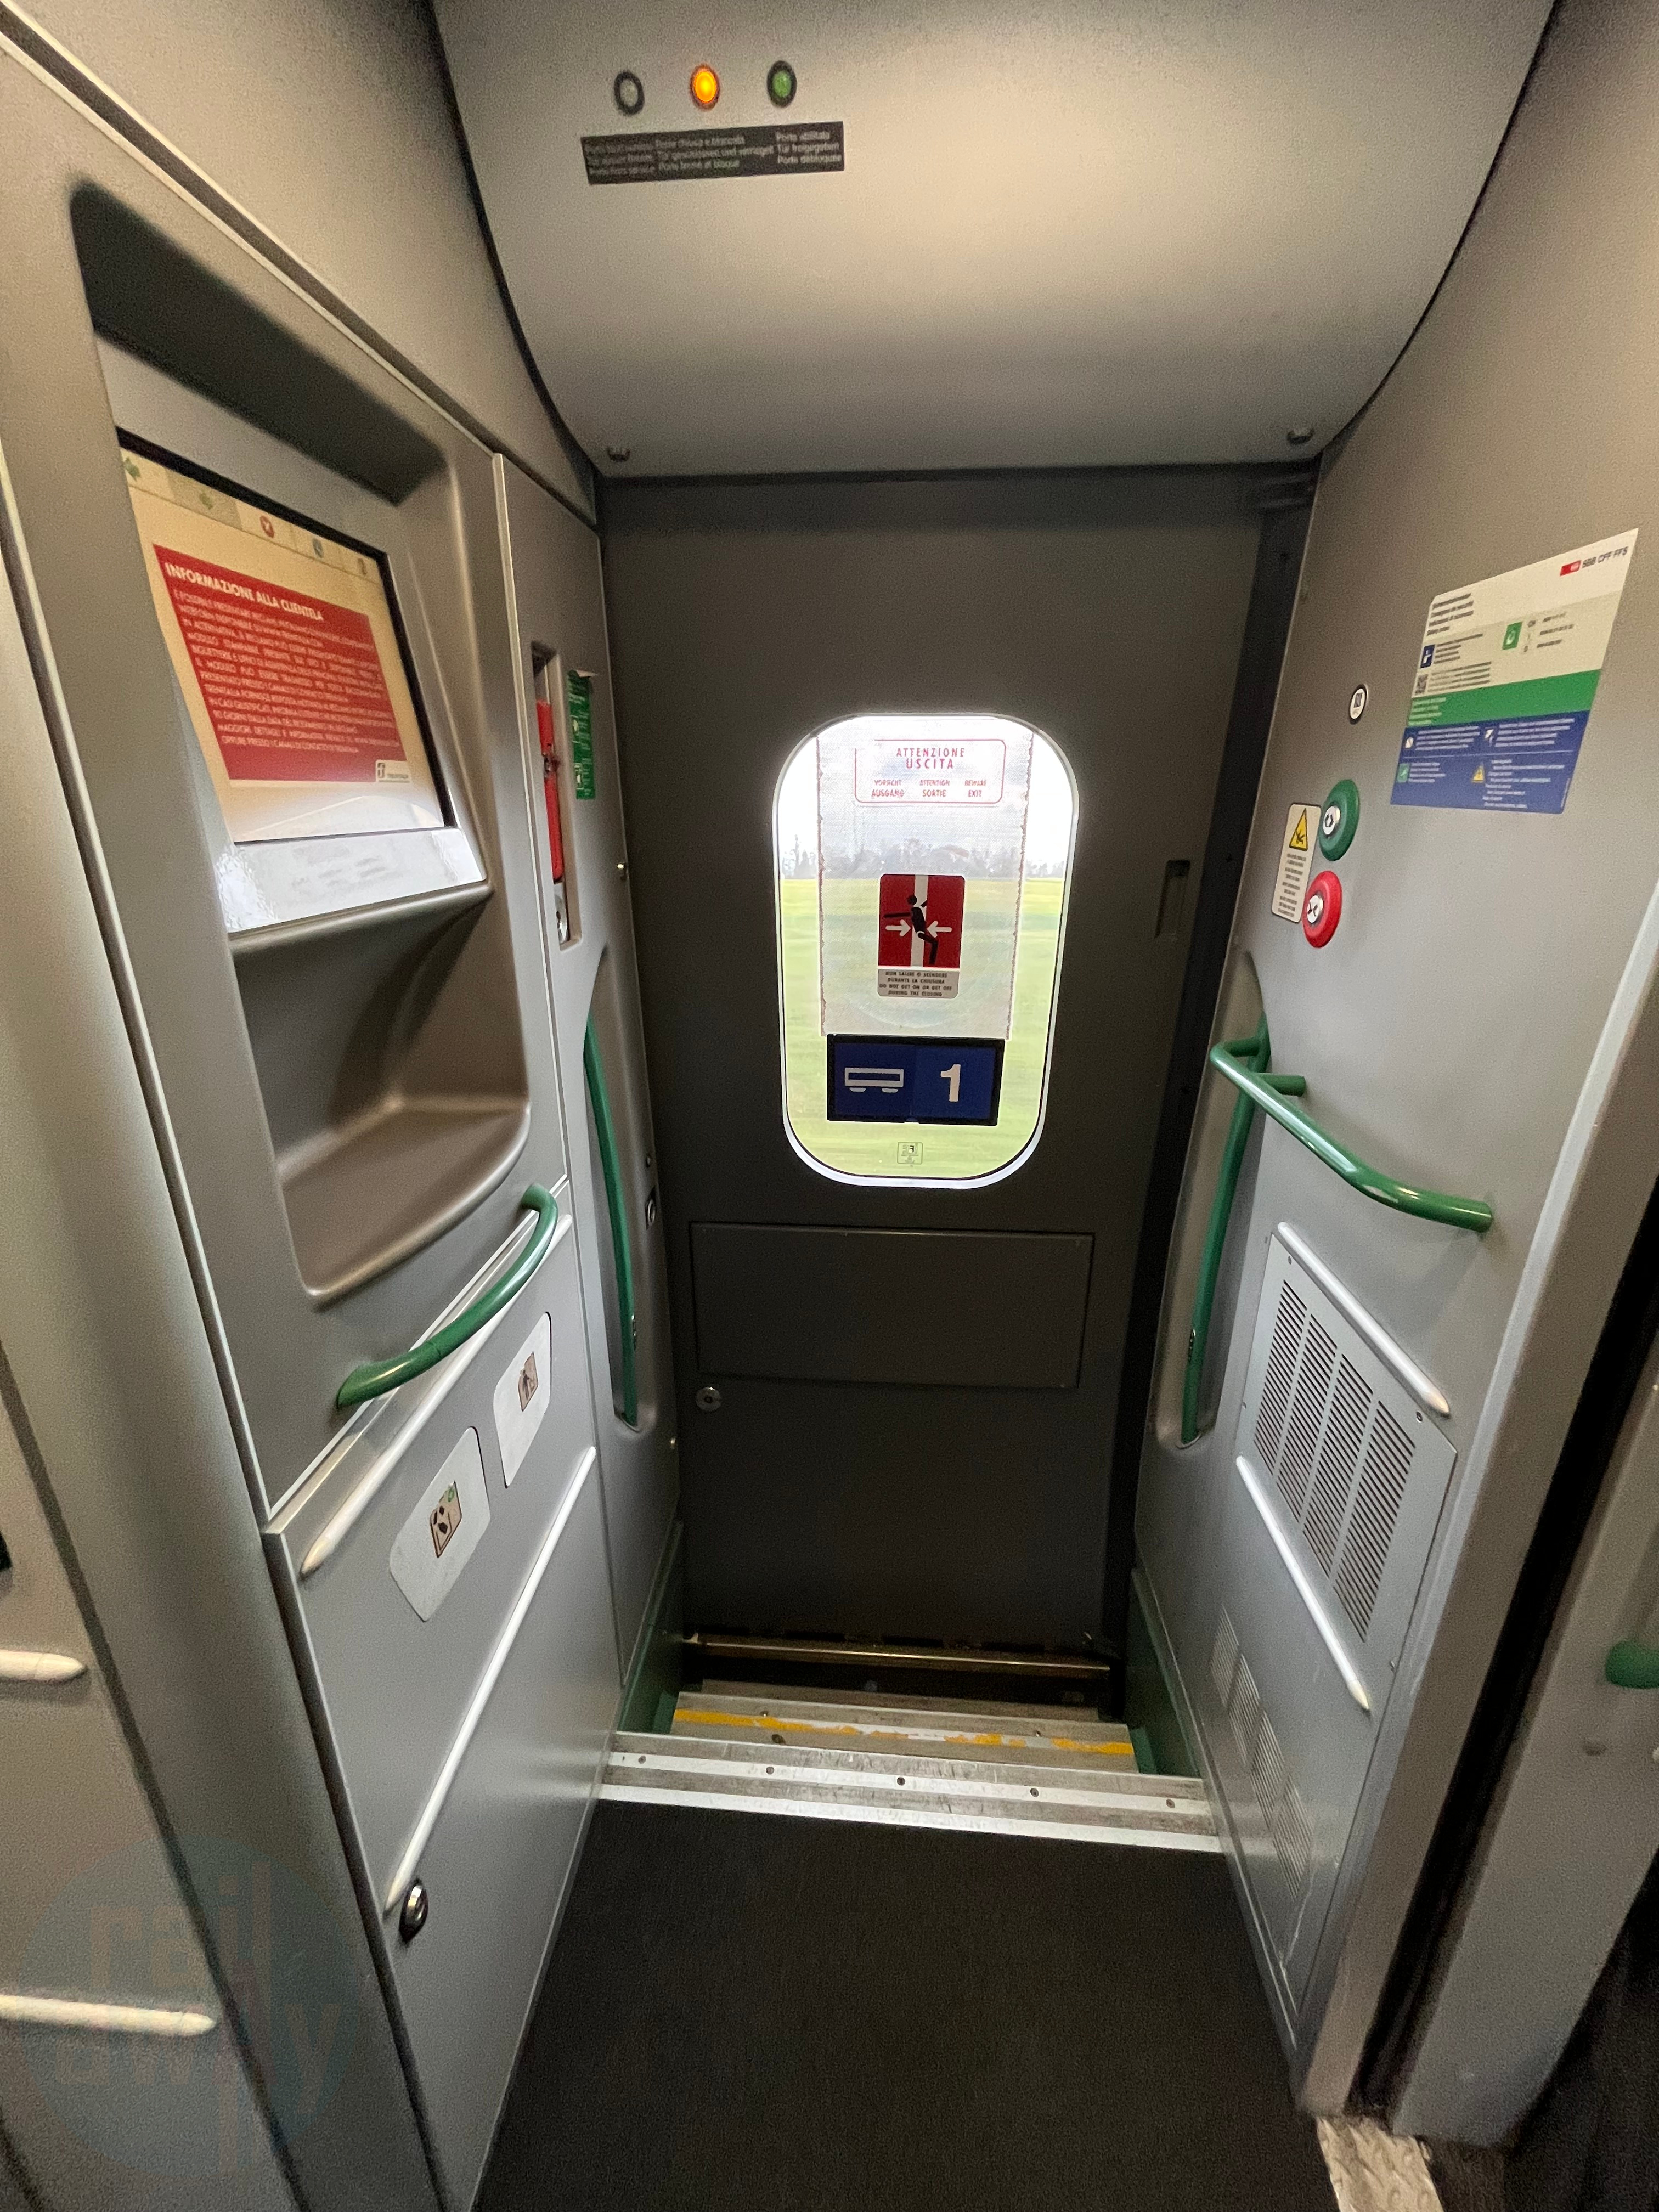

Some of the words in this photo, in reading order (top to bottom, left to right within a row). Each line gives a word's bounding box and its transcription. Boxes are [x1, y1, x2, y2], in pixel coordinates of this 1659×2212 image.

[1582, 556, 1597, 568] SBB
[1598, 551, 1612, 564] CFF
[1613, 546, 1629, 558] FFS
[165, 562, 255, 602] INFORMAZIONE
[256, 591, 280, 609] ALLA
[280, 599, 324, 622] CLIENTELA
[896, 748, 965, 757] ATTENZIONE
[906, 758, 953, 769] USCITA
[871, 789, 905, 798] AUSGANG
[922, 789, 947, 798] SORTIE
[968, 789, 983, 798] EXIT
[941, 1063, 961, 1102] 1
